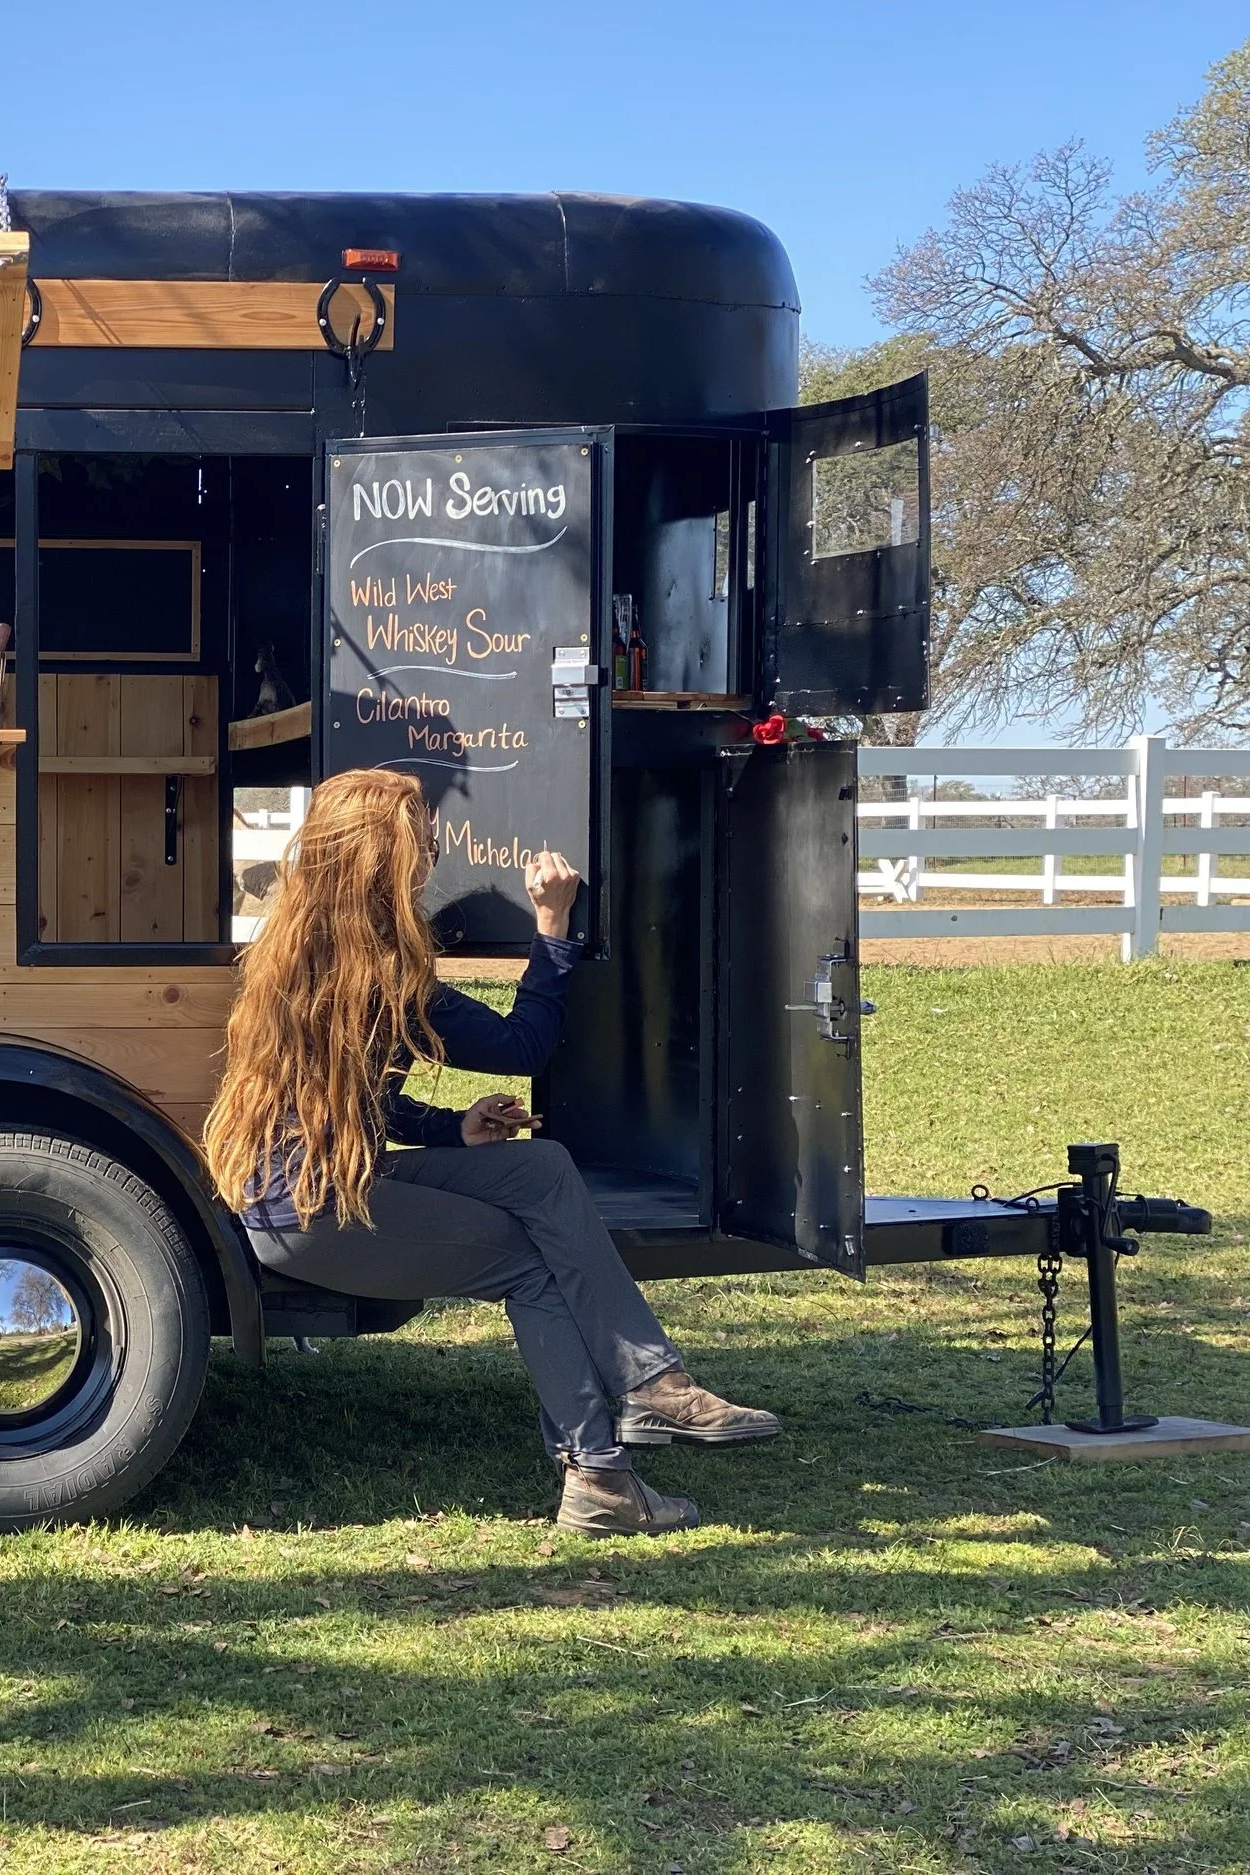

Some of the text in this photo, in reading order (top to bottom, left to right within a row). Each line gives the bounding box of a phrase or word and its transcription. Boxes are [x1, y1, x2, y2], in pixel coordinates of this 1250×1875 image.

[353, 472, 566, 521] NOW Serving
[351, 572, 458, 607] Wild West
[367, 608, 531, 665] Whiskey Sour
[357, 687, 450, 724] Cilantro
[408, 723, 528, 757] Margarita
[446, 820, 548, 869] Michela
[24, 1434, 137, 1511] RADIAL
